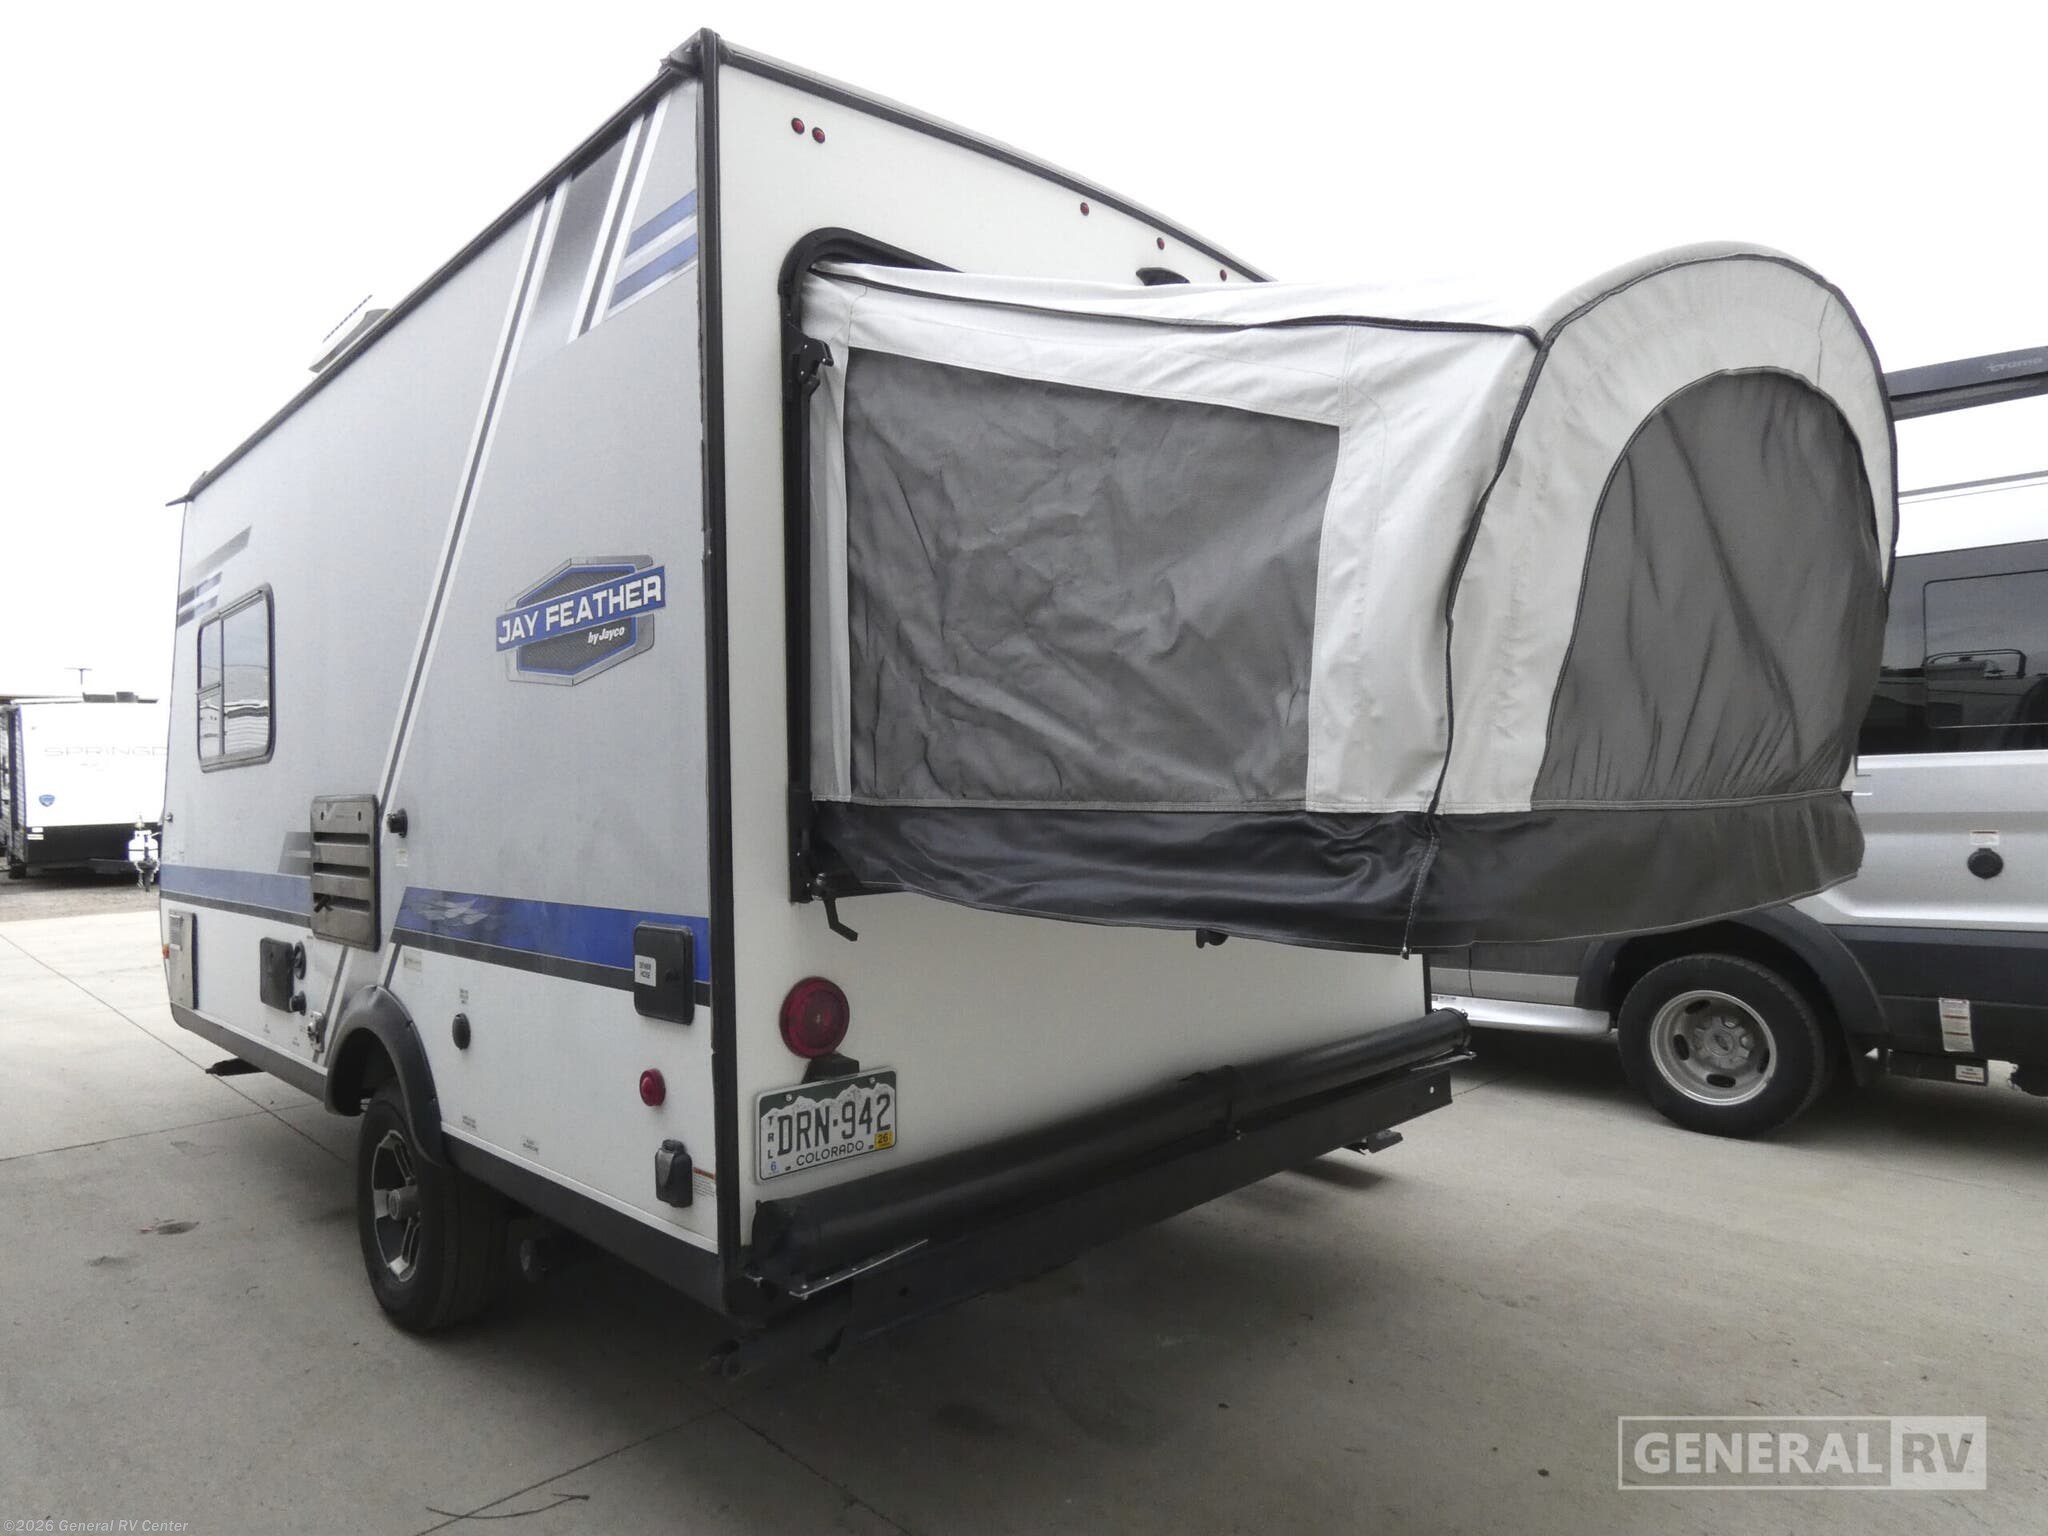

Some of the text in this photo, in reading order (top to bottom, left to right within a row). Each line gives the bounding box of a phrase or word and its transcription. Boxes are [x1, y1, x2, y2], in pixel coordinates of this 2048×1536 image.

[498, 575, 662, 644] JAY FEATHER
[587, 626, 625, 645] by Jayco
[877, 1133, 889, 1144] 26
[796, 1140, 864, 1167] COLORADO
